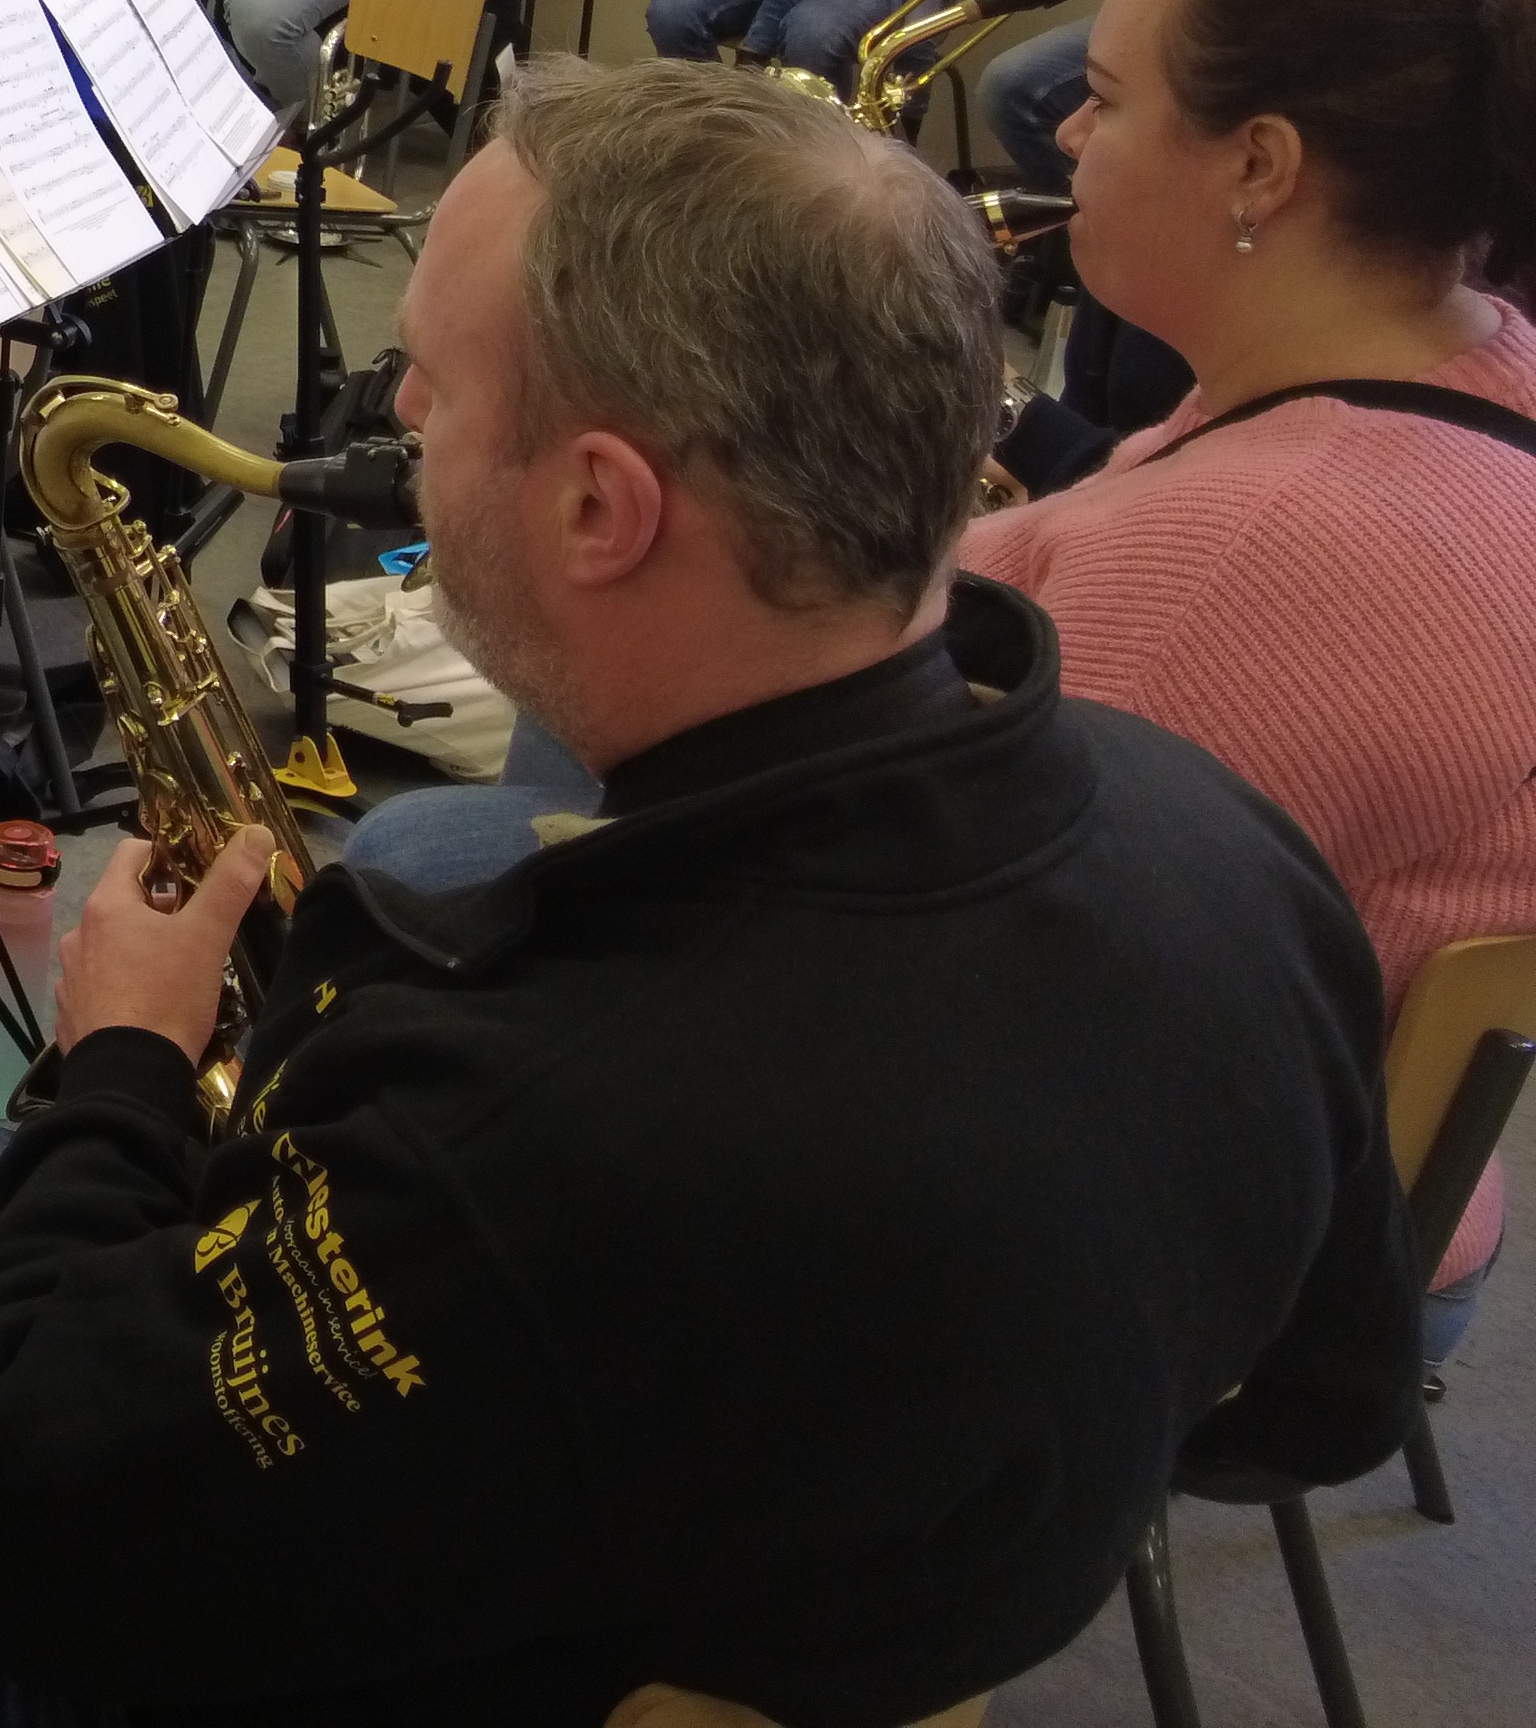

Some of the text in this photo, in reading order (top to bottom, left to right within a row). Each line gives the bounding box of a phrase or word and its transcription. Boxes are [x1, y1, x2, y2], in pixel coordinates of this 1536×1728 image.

[216, 1263, 306, 1457] Bruijnes
[268, 1246, 362, 1415] Machineservice
[271, 1131, 427, 1399] Westerink
